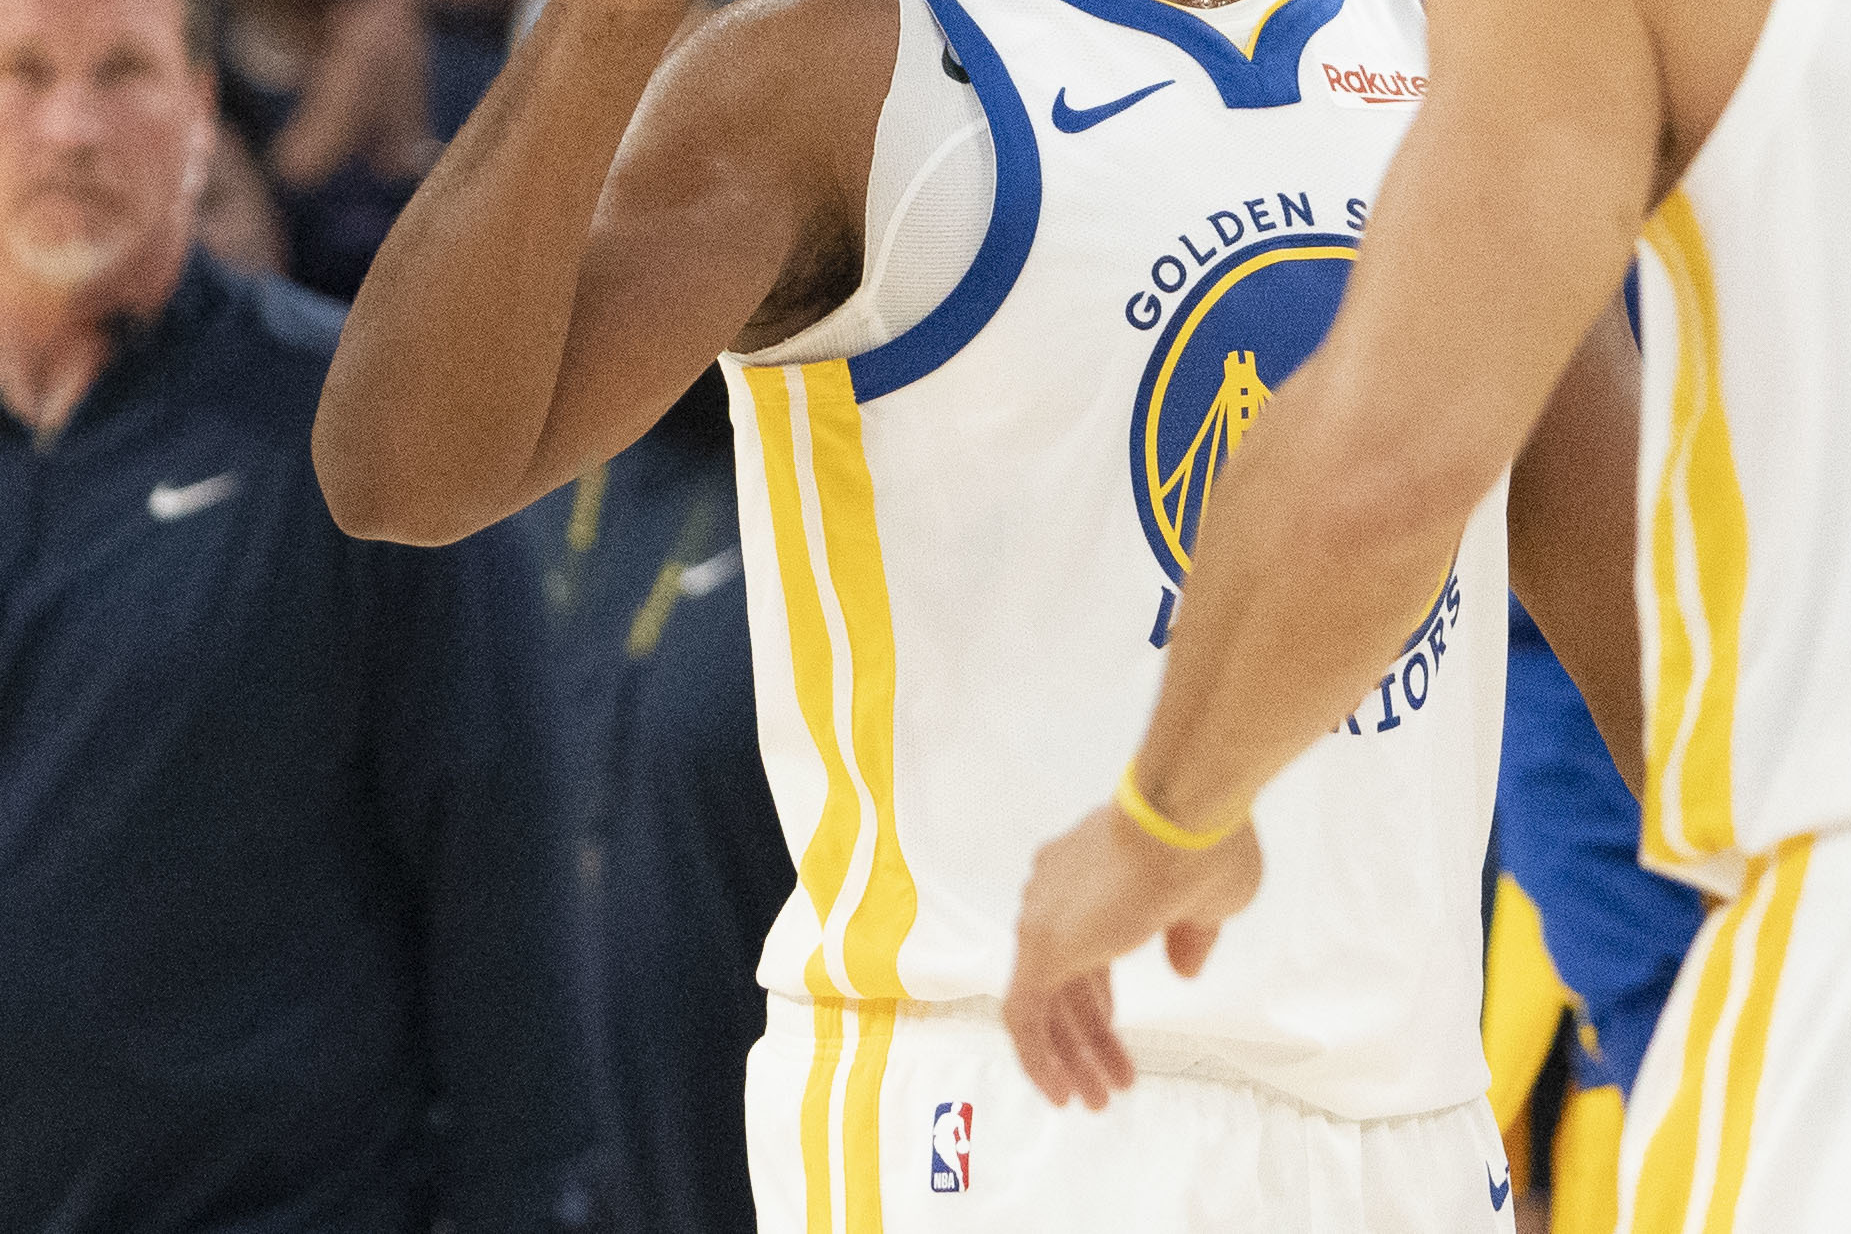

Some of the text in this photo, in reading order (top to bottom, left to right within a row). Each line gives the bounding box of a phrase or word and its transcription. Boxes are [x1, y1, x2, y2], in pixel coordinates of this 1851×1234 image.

[1321, 62, 1430, 97] Rakute
[1125, 191, 1315, 331] GOLDEN
[933, 1171, 955, 1189] NBA
